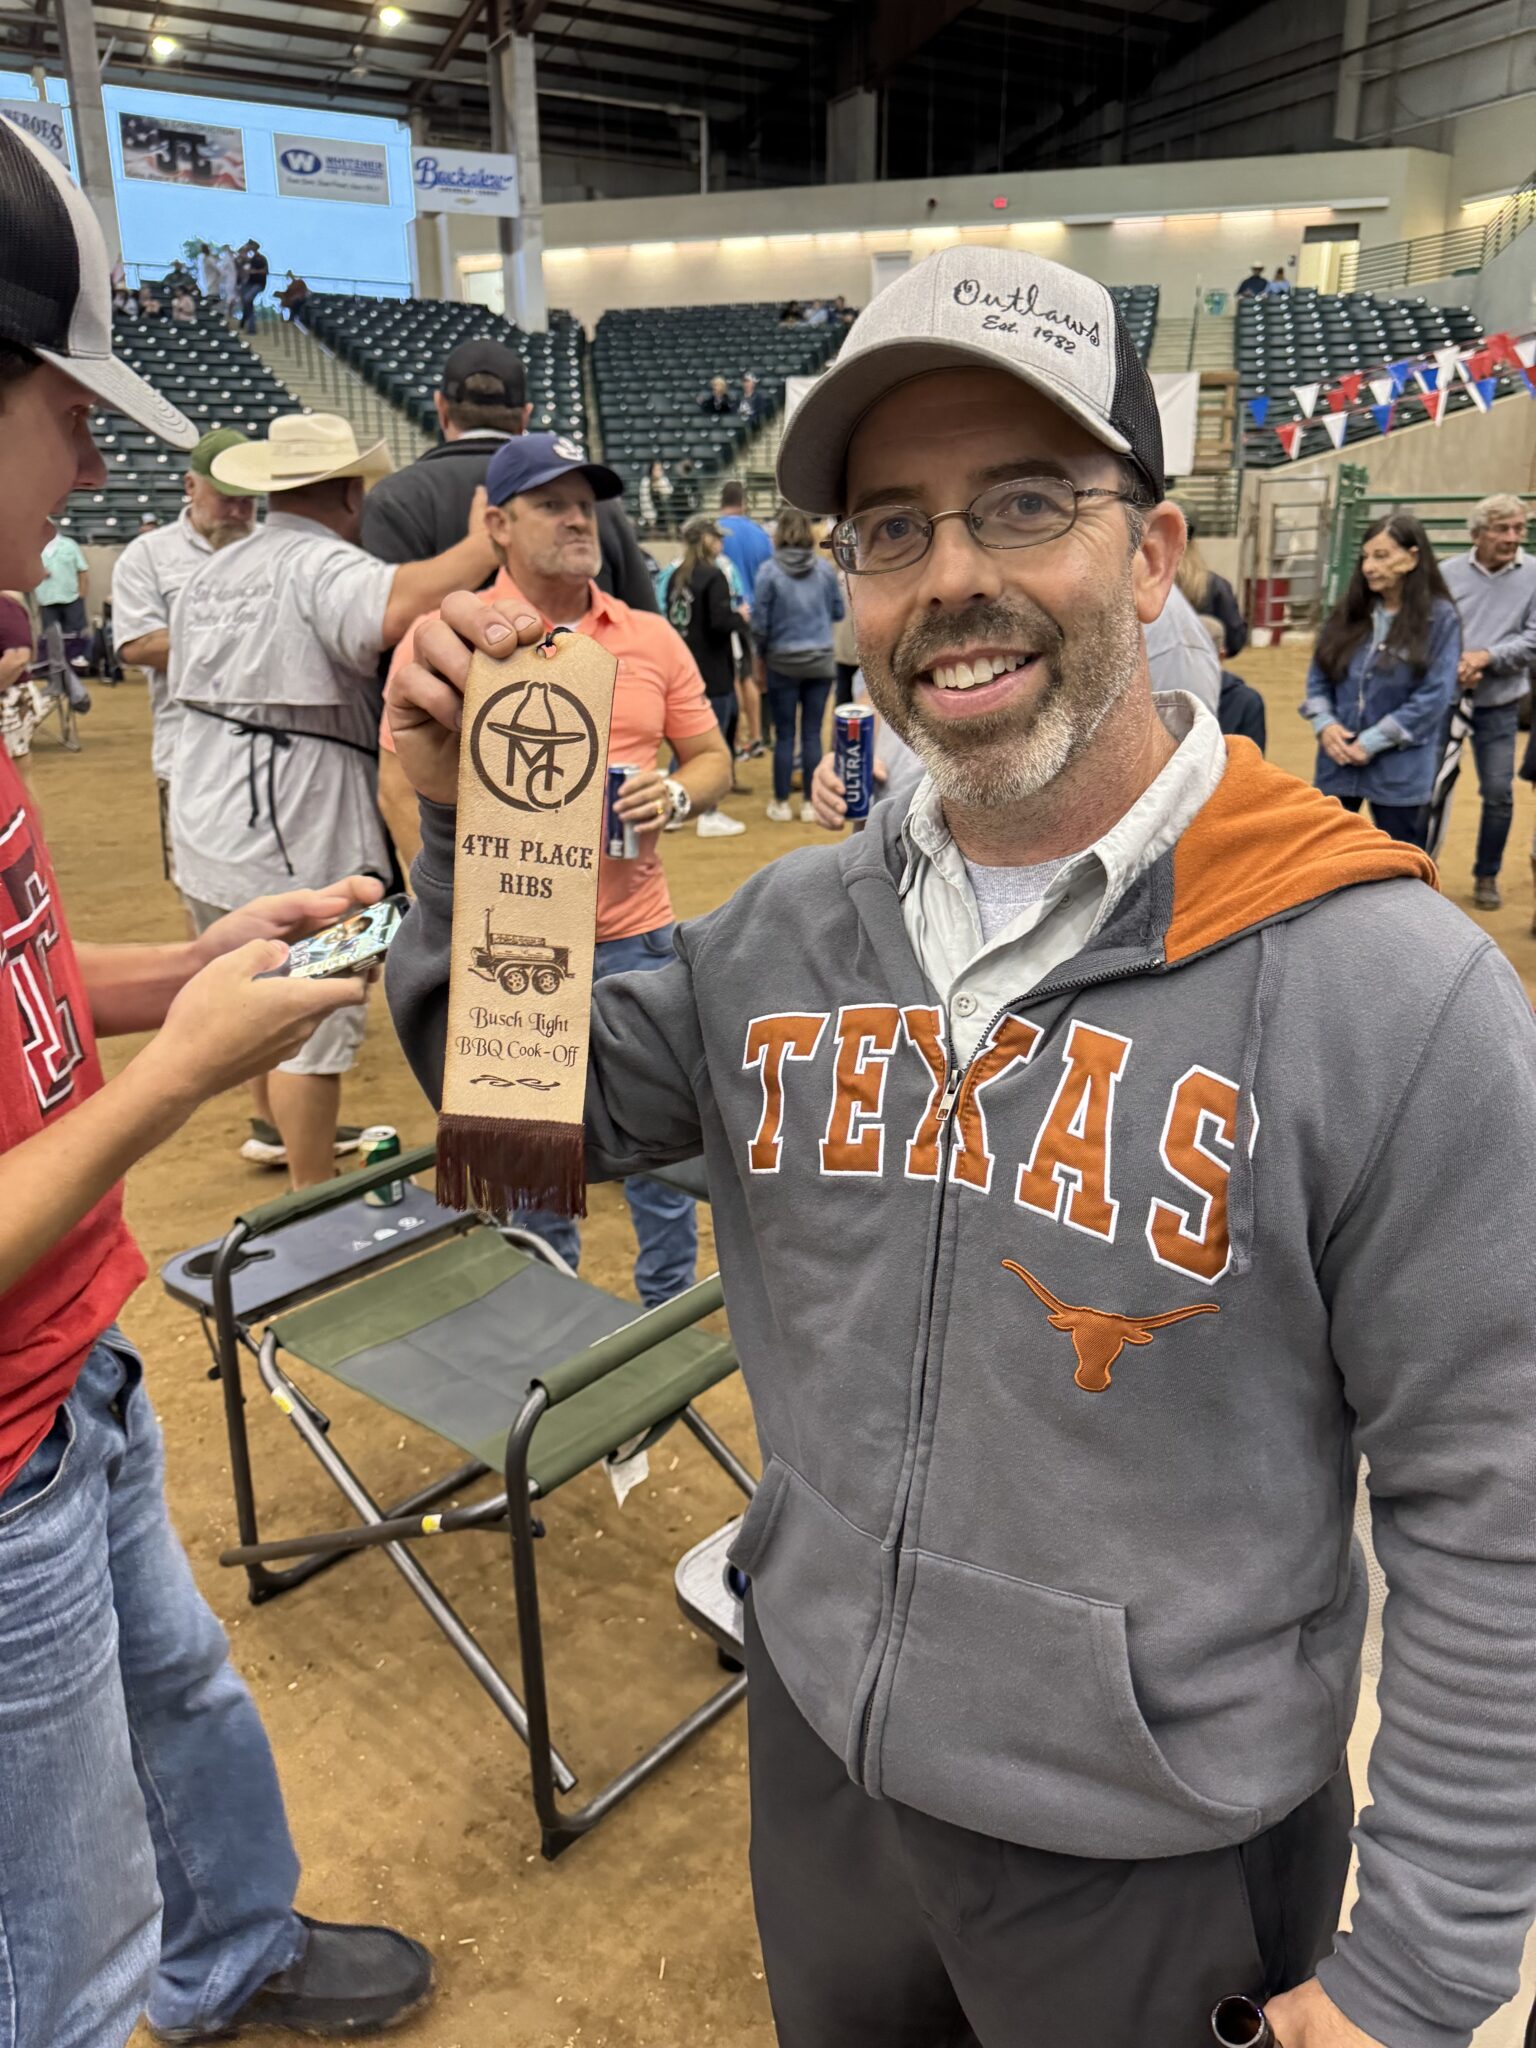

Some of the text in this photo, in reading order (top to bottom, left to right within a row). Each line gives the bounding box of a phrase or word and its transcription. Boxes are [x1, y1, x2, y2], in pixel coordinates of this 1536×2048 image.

[953, 279, 1100, 347] Outlaws
[1032, 326, 1077, 355] 1982
[846, 744, 861, 803] ULTRA
[461, 834, 594, 869] 4TH PLACE
[499, 872, 553, 899] RIBS
[468, 1006, 569, 1038] Busch Light
[455, 1036, 580, 1067] BBQ Cook-Off
[742, 1003, 1260, 1286] TEXAS
